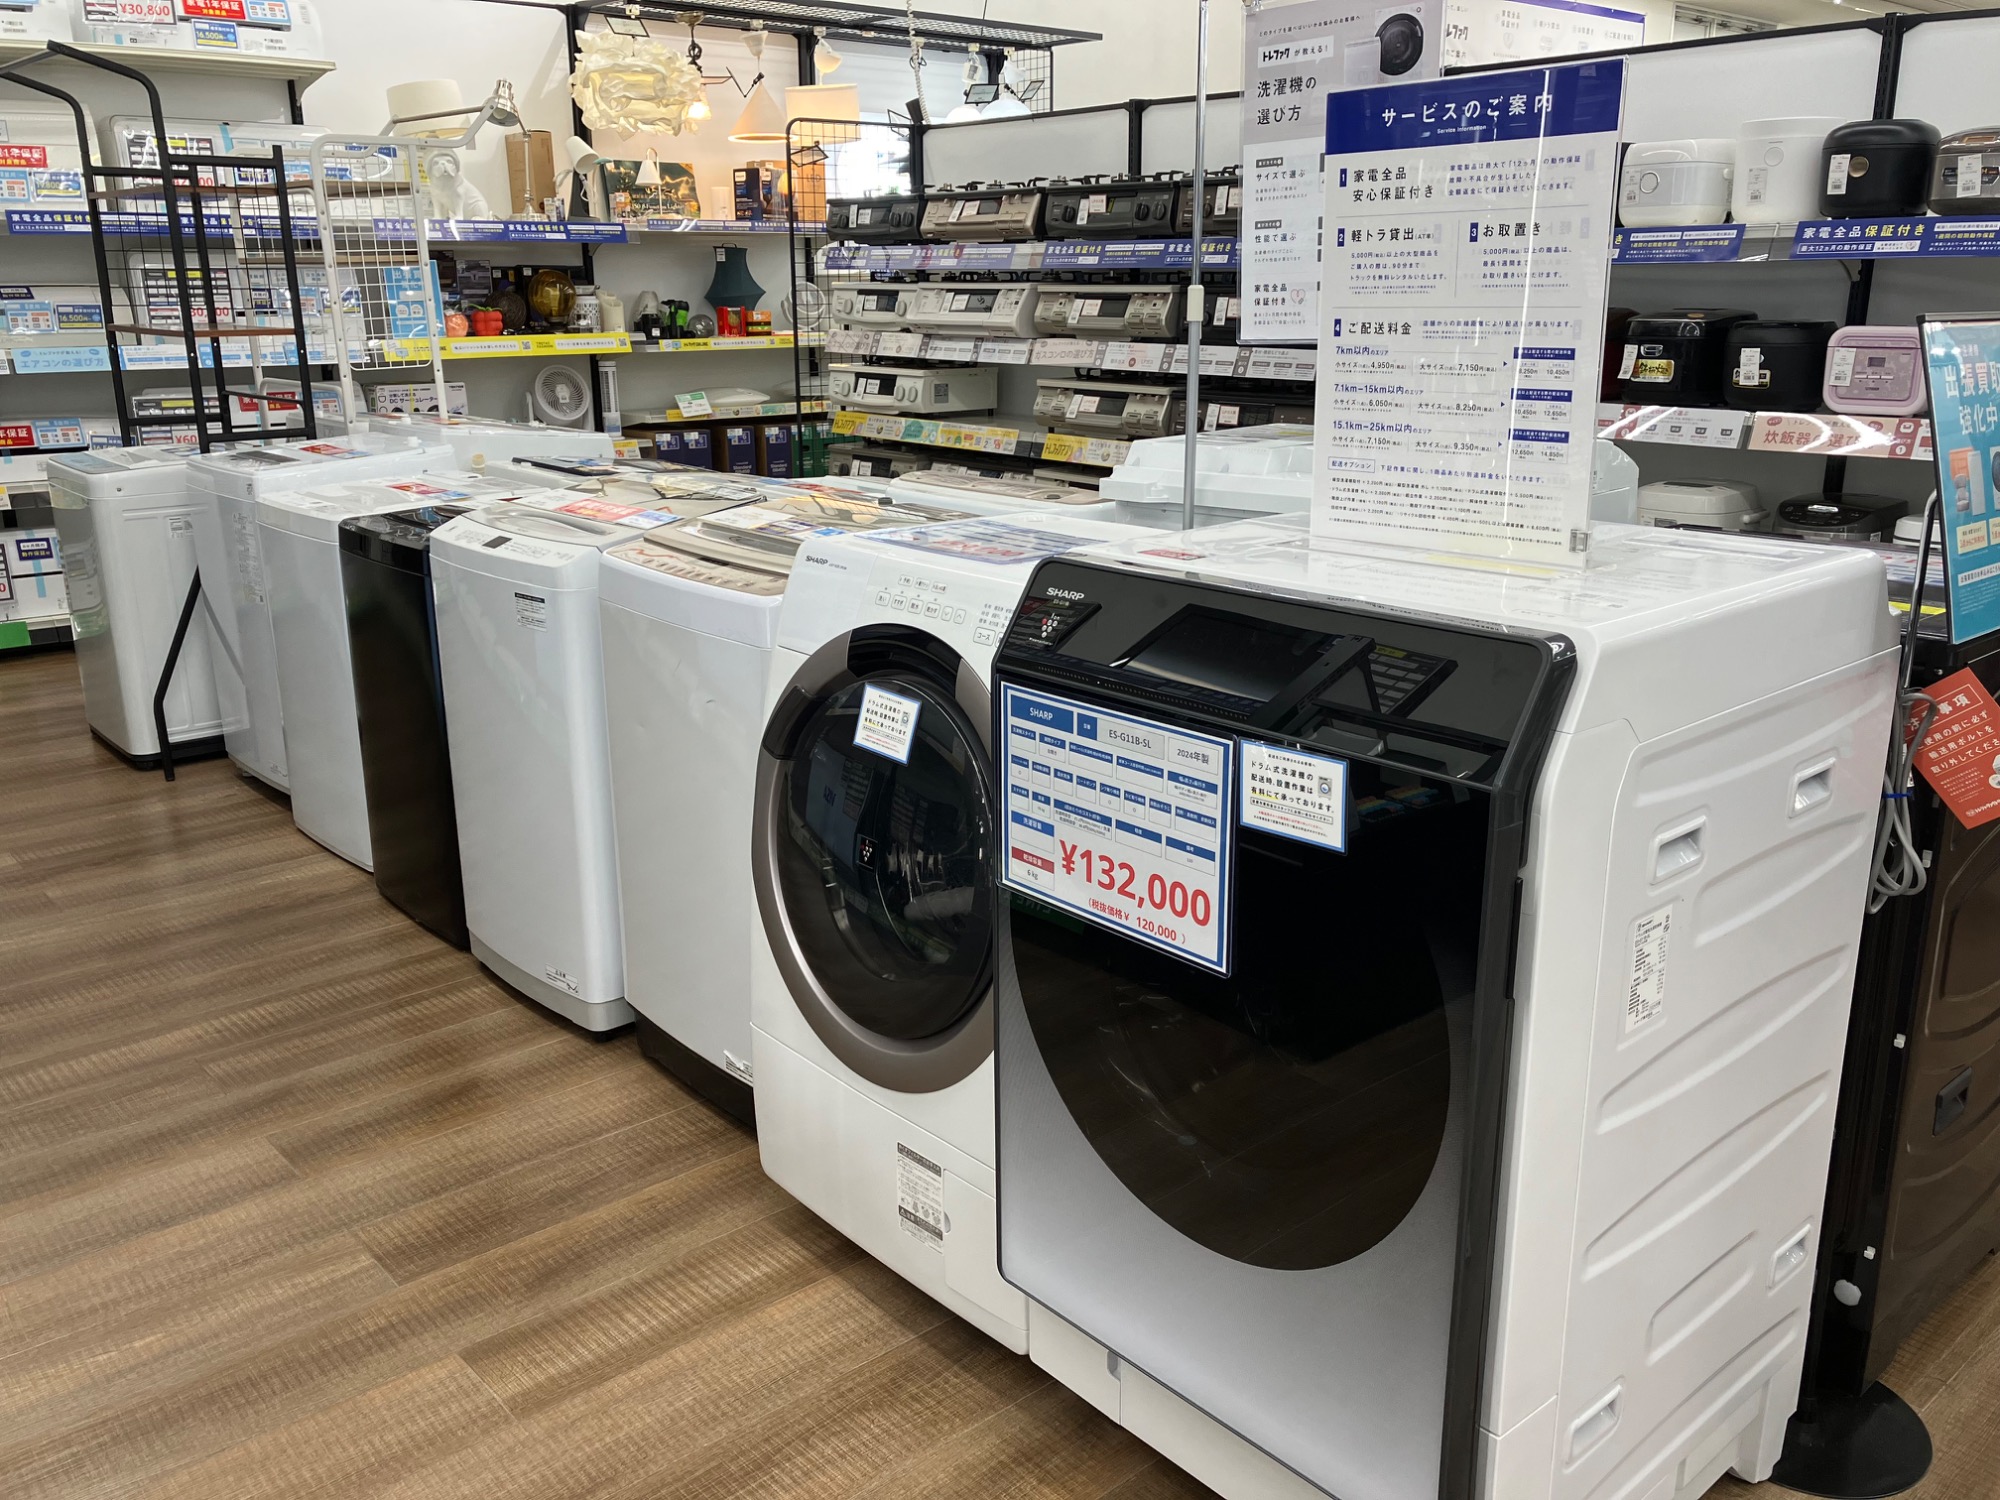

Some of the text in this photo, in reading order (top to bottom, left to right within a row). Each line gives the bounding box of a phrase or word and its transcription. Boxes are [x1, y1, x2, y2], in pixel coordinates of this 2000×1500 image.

[119, 3, 170, 17] ¥30,800
[1257, 76, 1317, 98] 洗濯機の
[1257, 104, 1302, 125] 選び方
[1381, 93, 1553, 127] サービスのご案内
[1450, 155, 1581, 172] 家電製品は最大で「12ヵ月の動作保証
[1256, 169, 1306, 182] サイズで選ぶ
[1353, 166, 1407, 183] 家電全品
[1353, 184, 1434, 203] 安心保証付き
[508, 222, 565, 232] 家電全品保証付き
[1483, 222, 1541, 238] お取置き
[1802, 223, 1926, 240] 家電全品保証付き
[1254, 232, 1297, 244] 性能で選ぶ
[1048, 245, 1102, 254] 家電全品保証付き
[1168, 243, 1231, 253] 家電全保証付き
[1350, 273, 1447, 281] トラックを無料レンタルいたします。
[1254, 282, 1288, 293] 家電全品
[1254, 297, 1287, 306] 保証付き
[1348, 321, 1412, 336] ご配送料金
[1034, 348, 1094, 361] ガスコンロの選び方
[1335, 345, 1389, 356] 7km以内のエリア
[21, 357, 104, 369] エアコンの選び方
[1958, 402, 1998, 436] 強化中
[1331, 460, 1372, 469] 配送オプション
[805, 555, 829, 566] SHARP
[1046, 587, 1085, 600] SHARP
[977, 632, 991, 641] コース
[1029, 707, 1054, 721] SHARP
[1907, 693, 1971, 732] 注事項
[1108, 729, 1152, 749] ES-G11B-SL
[1928, 725, 1994, 760] 輸送用ボルトを
[1176, 748, 1210, 766] 2024年製
[1251, 760, 1314, 781] ドラム式洗濯機の
[1250, 773, 1314, 795] 配送時、設置作業は
[1250, 785, 1335, 814] 有料にて承っております。
[1059, 839, 1211, 927] ¥132,000
[1136, 916, 1177, 941] 120,000
